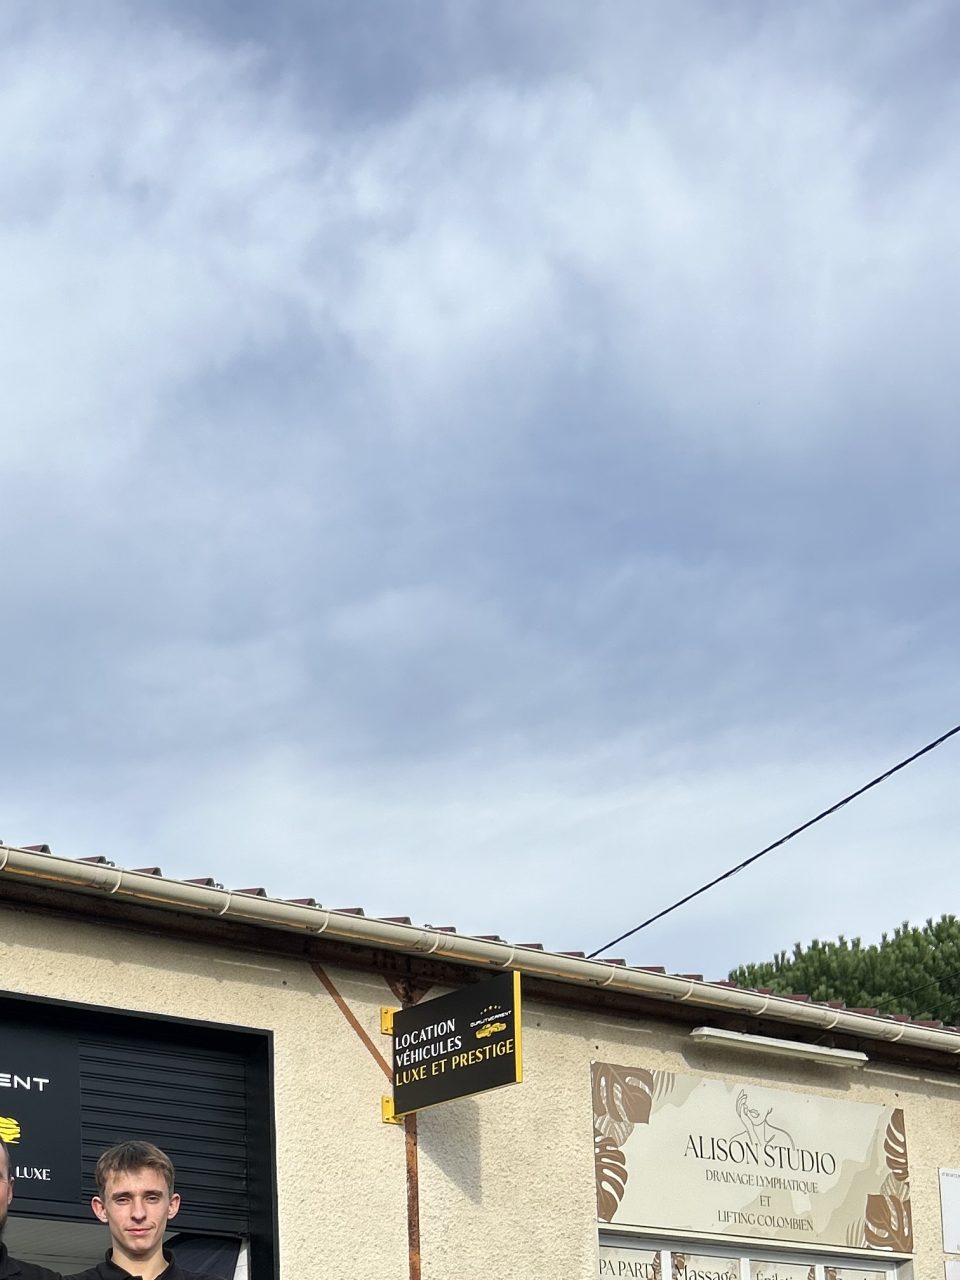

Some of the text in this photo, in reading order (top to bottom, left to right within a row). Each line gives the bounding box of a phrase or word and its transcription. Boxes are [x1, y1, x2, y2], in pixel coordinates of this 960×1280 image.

[395, 1018, 456, 1050] LOCATION
[395, 1036, 463, 1067] VÉHICULES
[395, 1038, 515, 1087] LUXE ET PRESTIGE
[684, 1134, 836, 1176] ALISON STUDIO
[15, 1165, 51, 1182] LUXE
[705, 1169, 819, 1195] DRAINAGE LYMPHATIQUE
[759, 1195, 771, 1208] ET
[717, 1210, 814, 1232] LIFTING COLOMBIEN
[599, 1259, 657, 1280] PA PARTY
